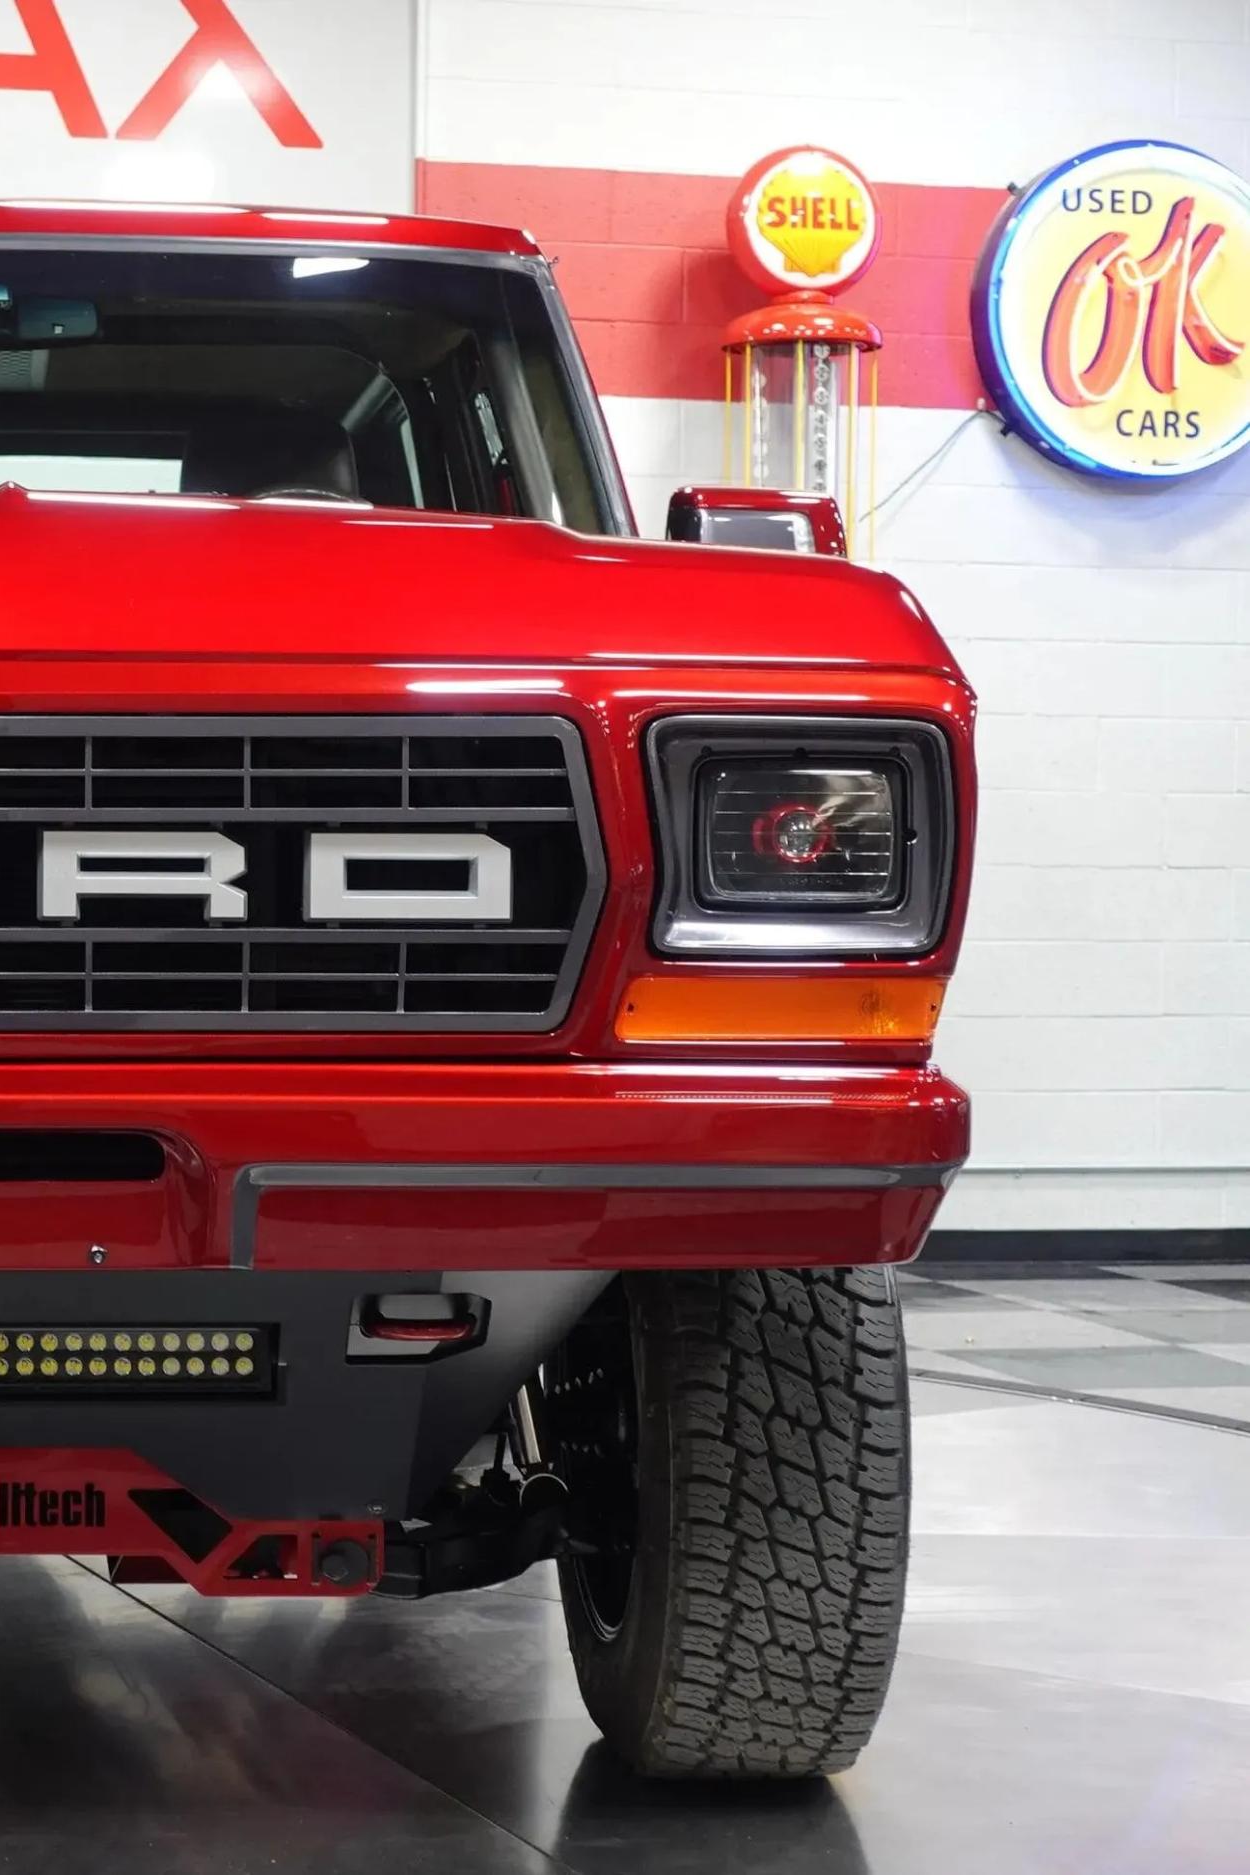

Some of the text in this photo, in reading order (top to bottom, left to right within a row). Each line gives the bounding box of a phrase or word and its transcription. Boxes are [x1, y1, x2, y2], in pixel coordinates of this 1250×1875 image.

[766, 196, 859, 231] SHELL
[1062, 188, 1153, 214] USED
[1116, 409, 1201, 438] CARS
